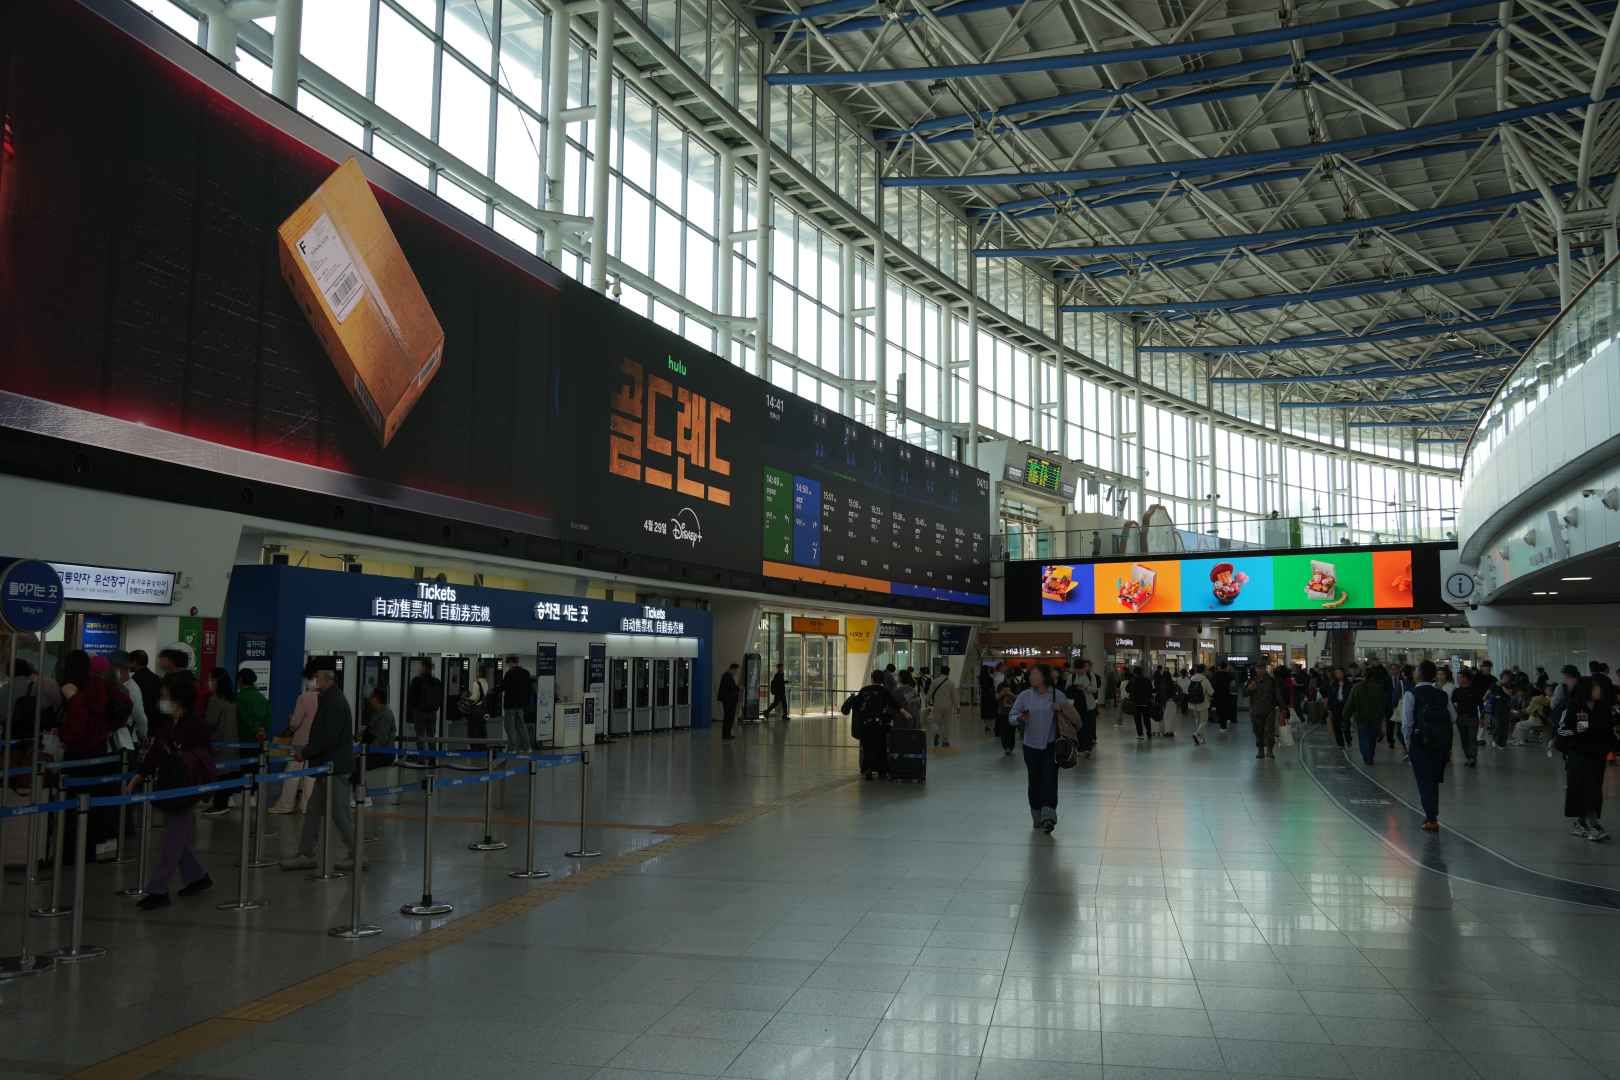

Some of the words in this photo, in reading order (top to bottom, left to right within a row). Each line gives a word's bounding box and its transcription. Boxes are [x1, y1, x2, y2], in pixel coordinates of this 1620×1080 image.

[667, 354, 688, 375] hulu
[765, 394, 785, 412] 14:41
[671, 508, 704, 548] Disney+
[417, 582, 457, 602] Tickets
[374, 597, 434, 619] 自动售票机
[438, 602, 491, 623] 自動券売機
[536, 601, 561, 621] 승차권
[562, 604, 579, 622] 사는
[580, 605, 589, 623] 곳
[643, 605, 667, 620] Tickets
